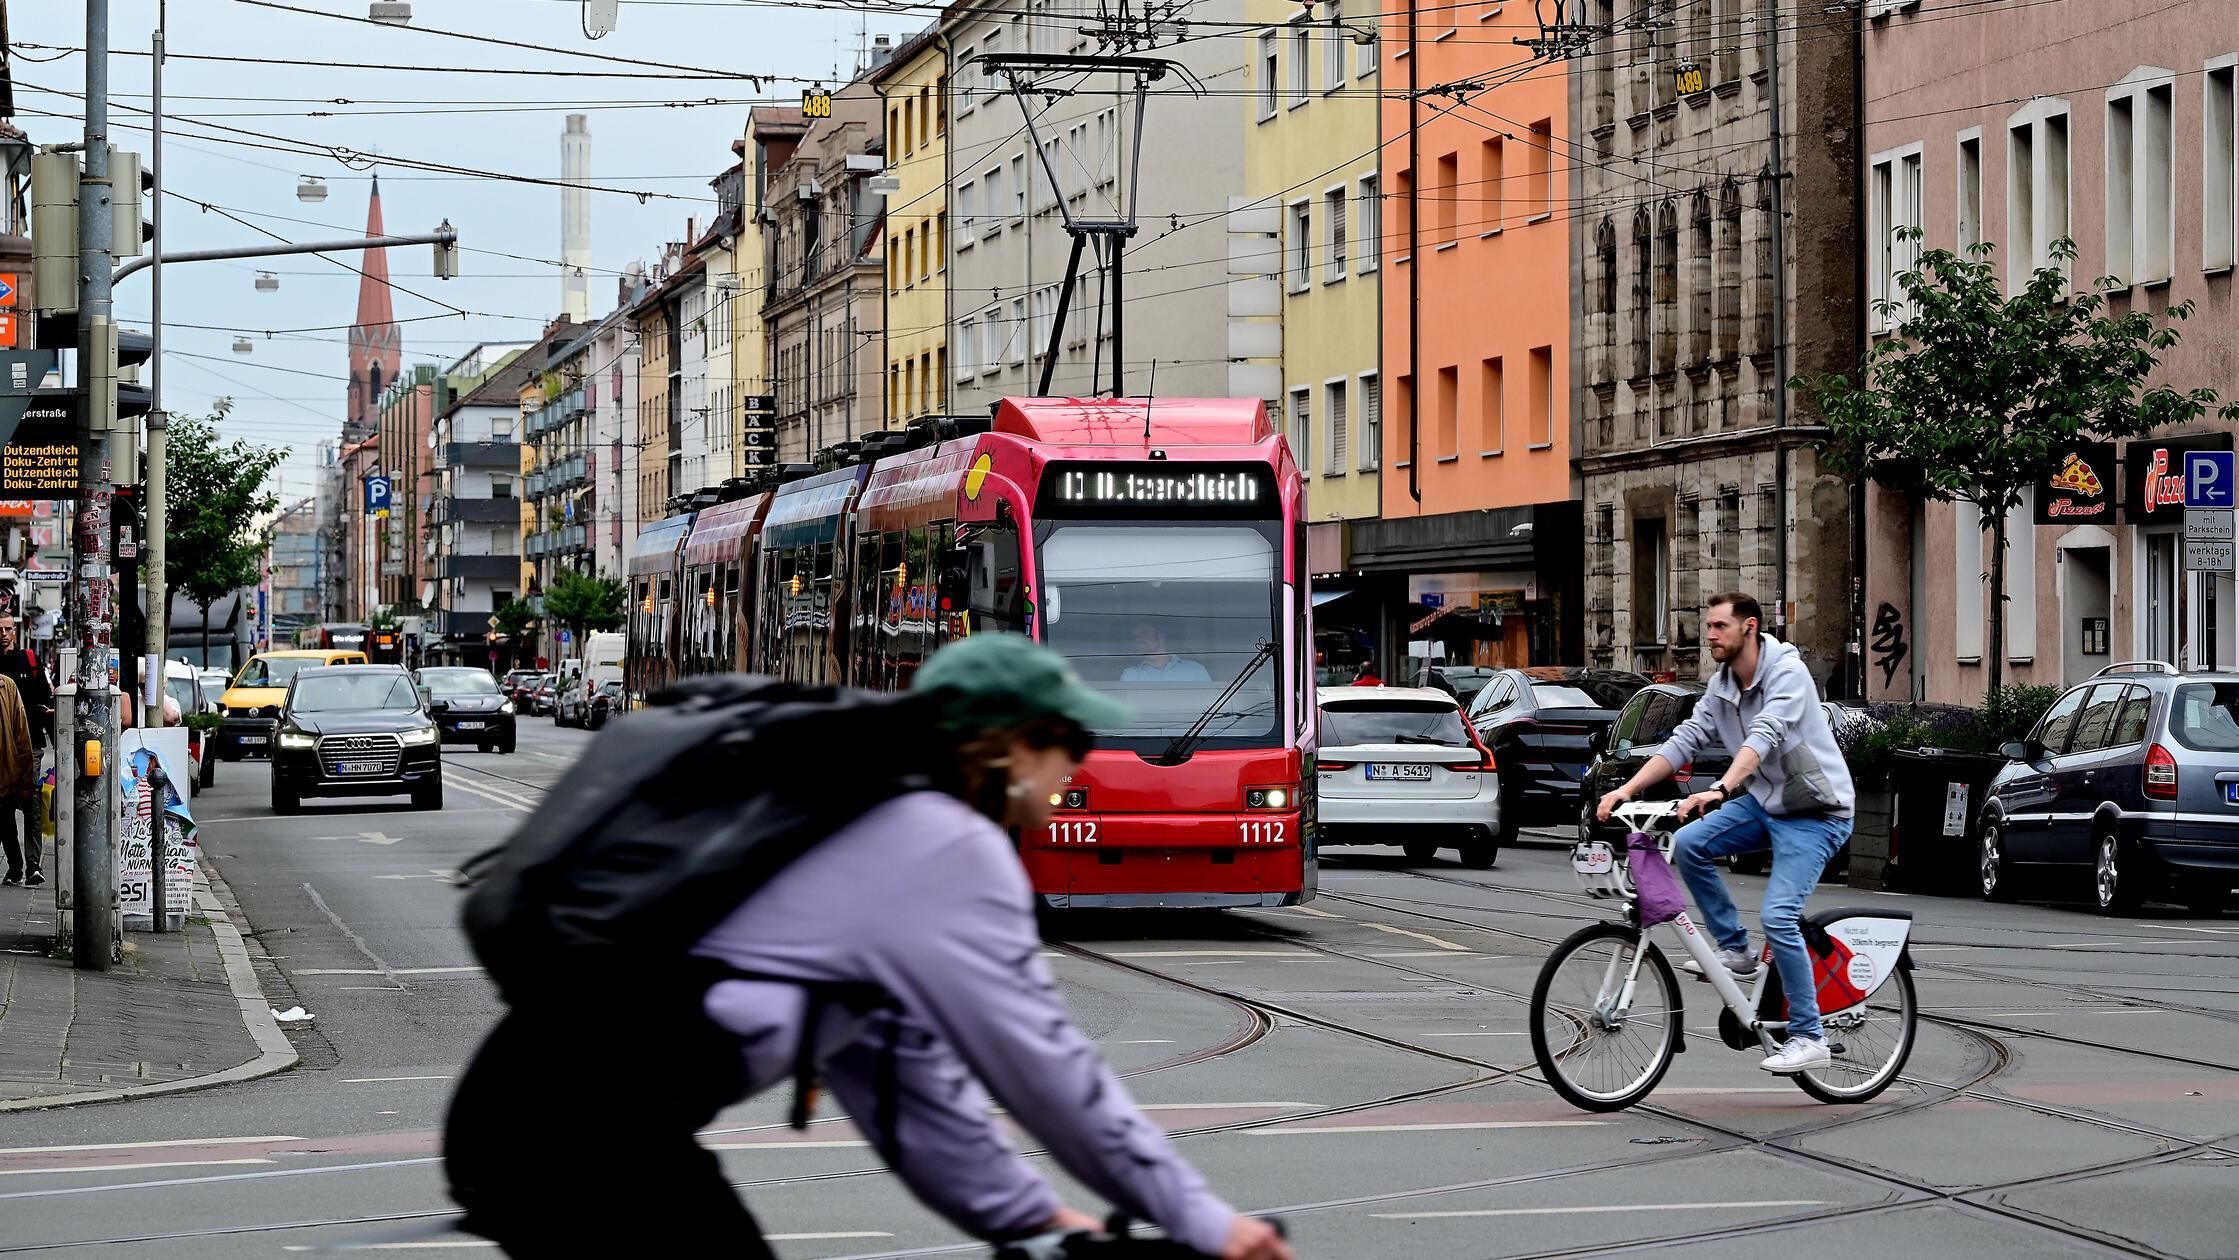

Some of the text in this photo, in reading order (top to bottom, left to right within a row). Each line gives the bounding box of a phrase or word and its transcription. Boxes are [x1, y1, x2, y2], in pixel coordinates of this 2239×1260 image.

[1676, 70, 1703, 95] 489
[803, 95, 831, 118] 488
[3, 445, 79, 456] Dutzendteich
[3, 467, 79, 478] Dutzendteich
[2193, 459, 2219, 500] P
[2203, 516, 2215, 524] mit
[2188, 525, 2230, 534] Parkschein
[2189, 547, 2230, 557] werktags
[363, 763, 382, 771] 7070
[1372, 766, 1430, 776] N A 5419
[1048, 822, 1097, 843] 1112
[1239, 822, 1285, 843] 1112
[127, 857, 179, 871] NÜRNRG
